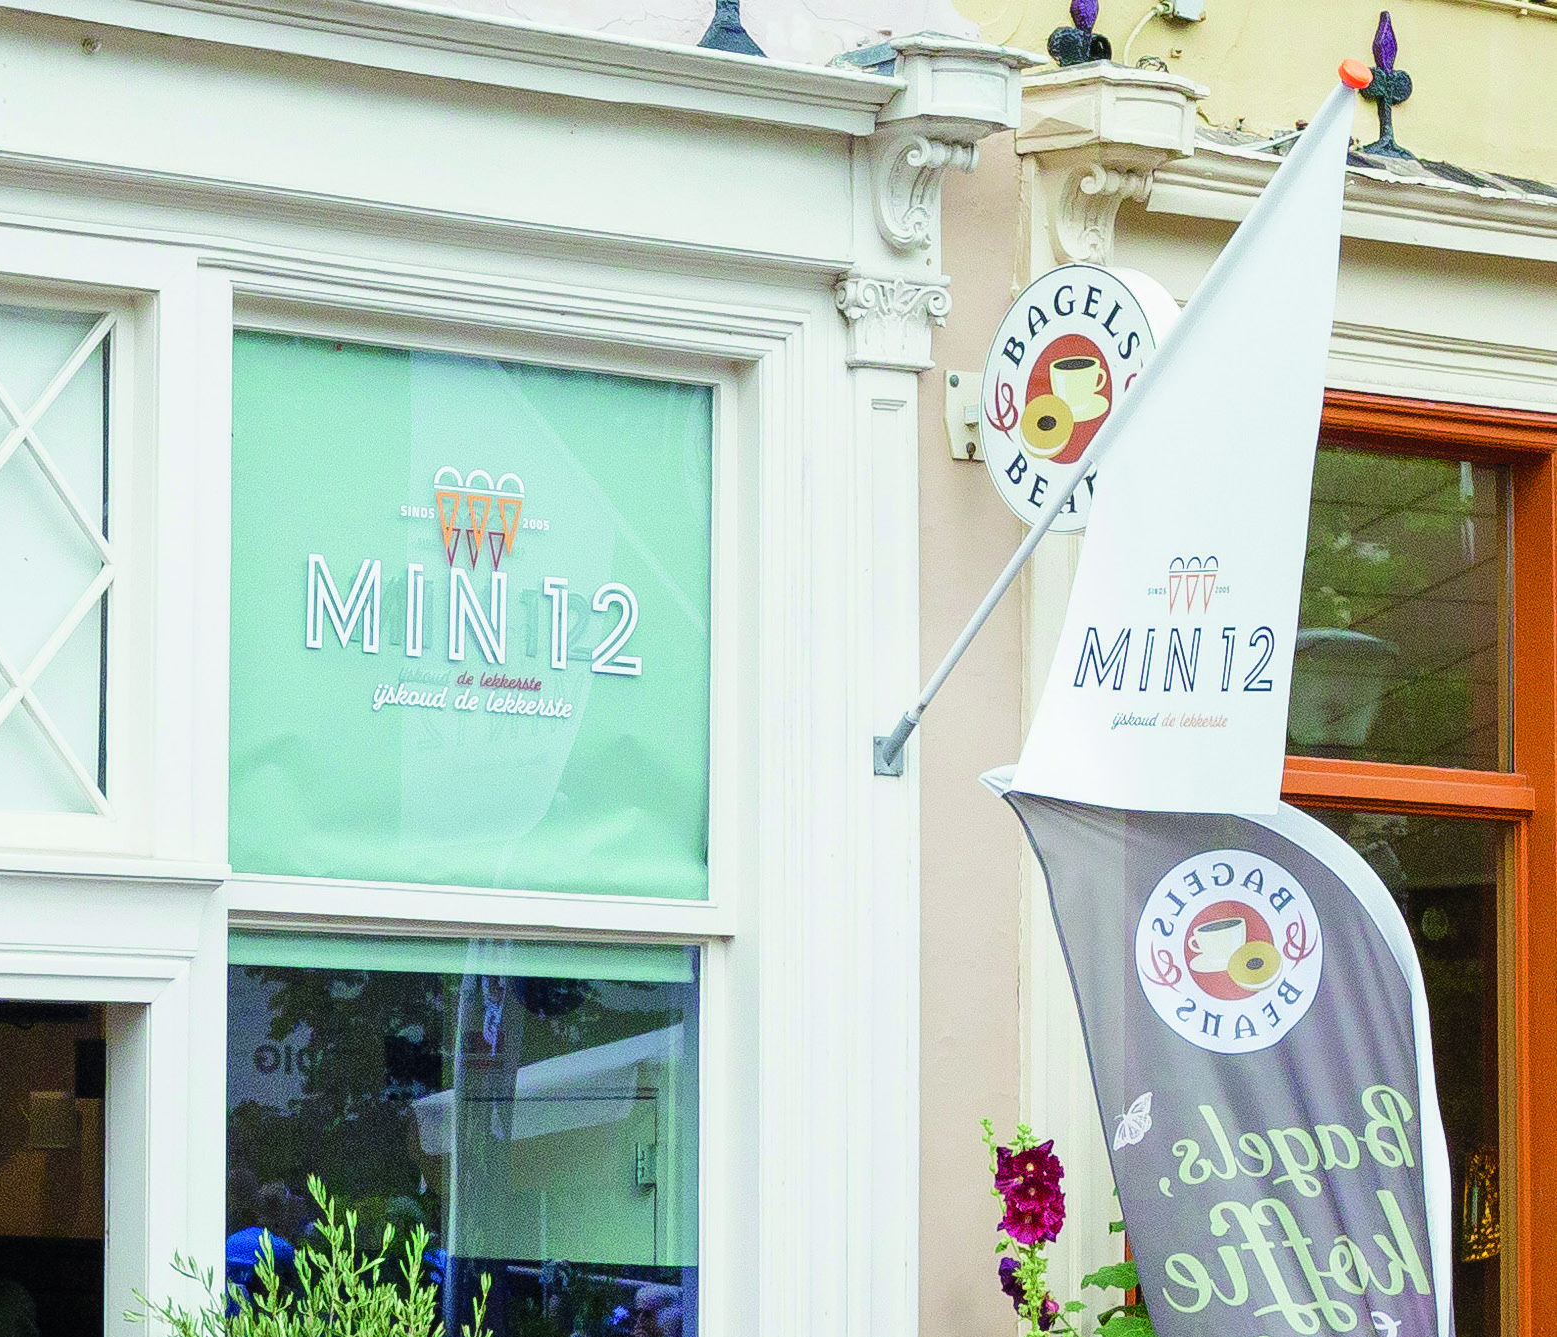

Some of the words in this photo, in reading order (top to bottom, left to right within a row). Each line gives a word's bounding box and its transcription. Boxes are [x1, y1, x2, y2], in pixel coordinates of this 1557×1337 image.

[1000, 284, 1141, 370] BAGELS
[1004, 449, 1098, 514] BEA
[400, 504, 435, 520] SINDS
[522, 517, 550, 532] 2005
[305, 553, 508, 665] MIN
[543, 576, 643, 677] 12
[1073, 627, 1202, 693] MIN
[1221, 625, 1275, 694] 12
[372, 683, 448, 712] ijskoud
[454, 689, 480, 712] de
[485, 689, 574, 719] lekkerste
[1161, 712, 1176, 728] de
